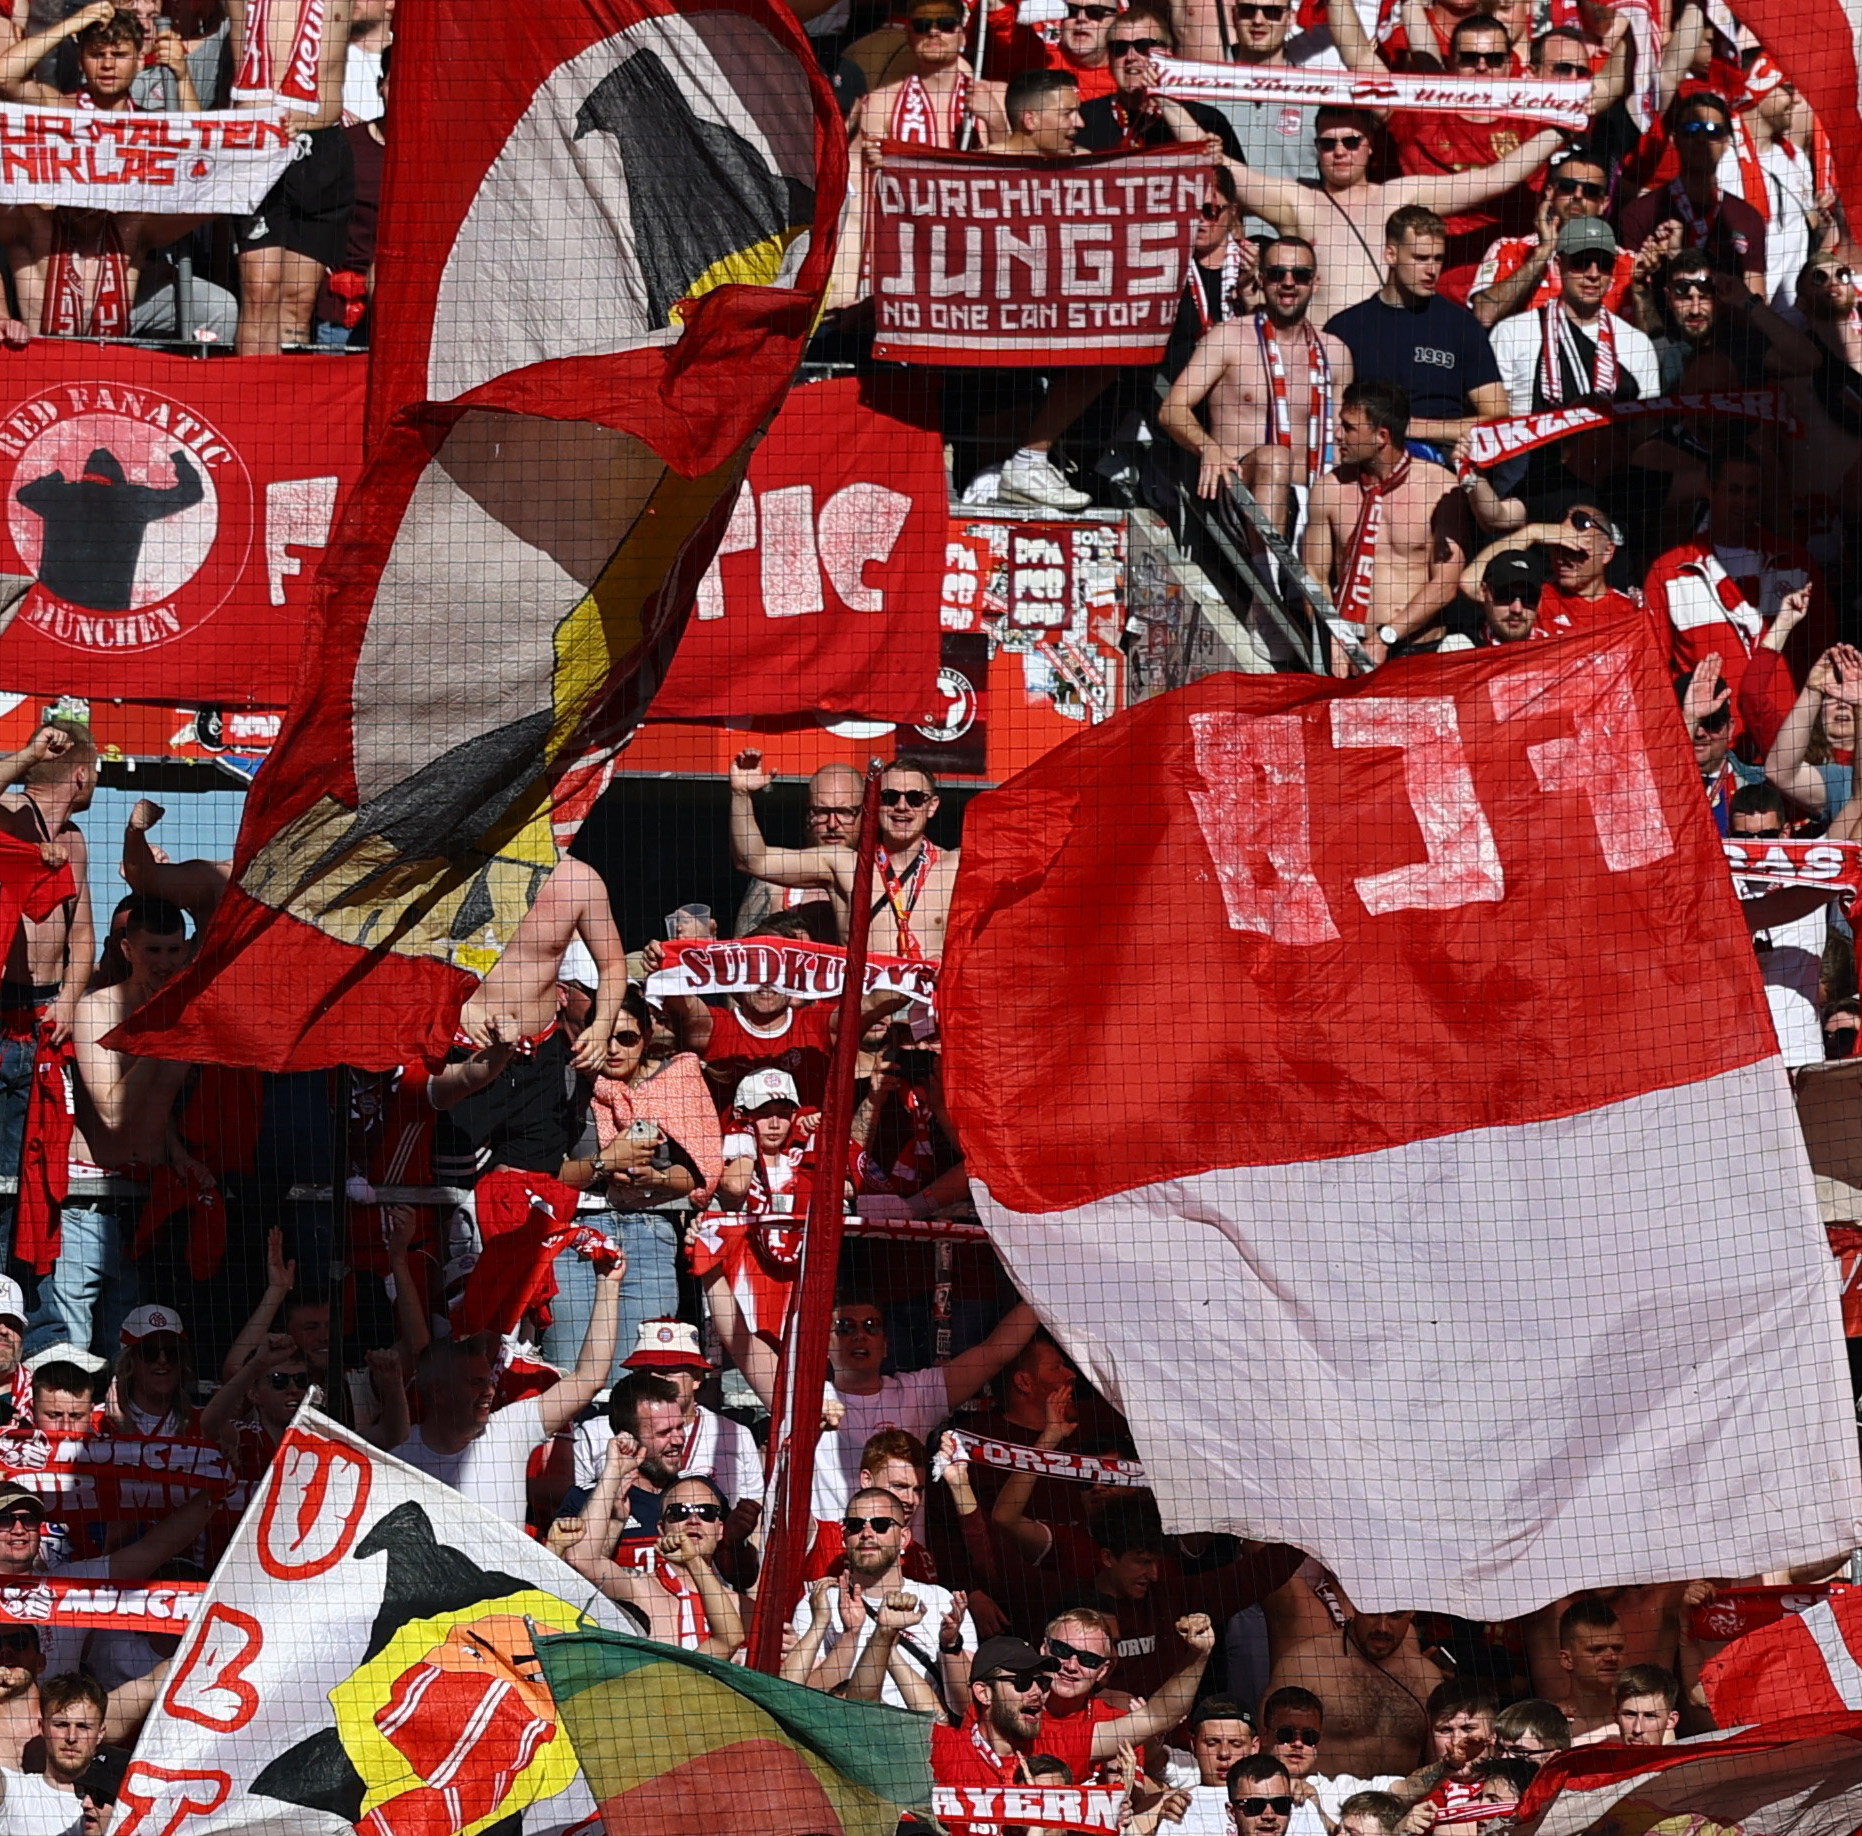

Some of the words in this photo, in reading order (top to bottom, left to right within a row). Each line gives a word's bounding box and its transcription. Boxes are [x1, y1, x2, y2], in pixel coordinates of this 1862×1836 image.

[2, 146, 176, 186] NIKLAS
[883, 171, 1207, 221] DURCHHALTEN
[882, 301, 923, 331] NO
[929, 301, 994, 331] ONE
[1000, 302, 1057, 330] CAN
[1064, 301, 1153, 332] STOP
[1413, 346, 1456, 369] 1999
[68, 384, 233, 470] FANATIC
[23, 592, 182, 650] MÜNCHEN
[684, 944, 936, 997] SÜDKUVE
[932, 1786, 1125, 1836] AYERN
